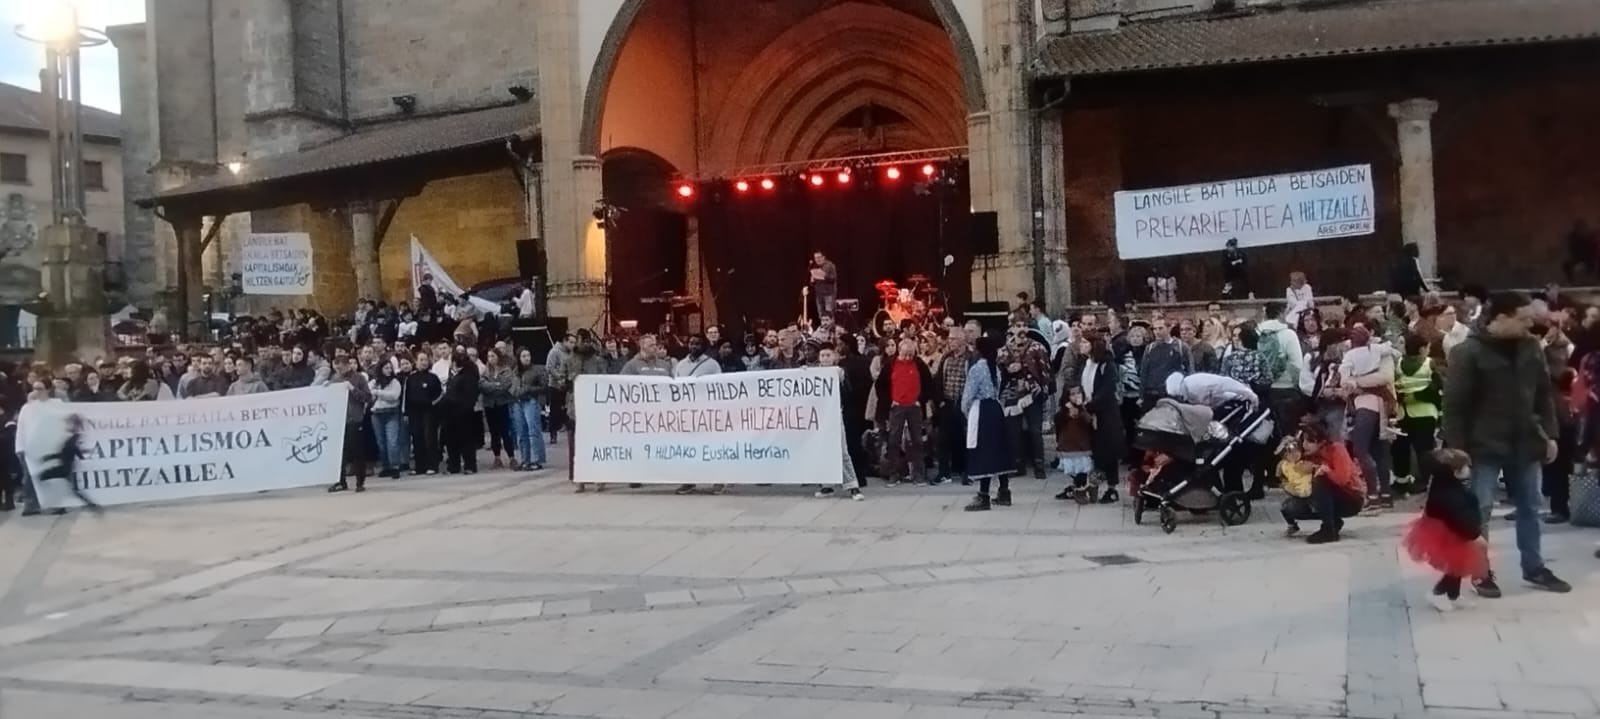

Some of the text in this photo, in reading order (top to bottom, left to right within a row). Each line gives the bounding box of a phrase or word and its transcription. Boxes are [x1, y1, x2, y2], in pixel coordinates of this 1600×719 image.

[1201, 183, 1227, 200] BAT
[669, 383, 697, 403] BAT
[241, 402, 328, 422] BETSAIDEN
[592, 446, 633, 461] AURTEN
[643, 444, 651, 460] 9
[702, 442, 739, 461] Euskal
[744, 442, 790, 460] Herrian
[73, 461, 235, 491] HILTZAILEA
